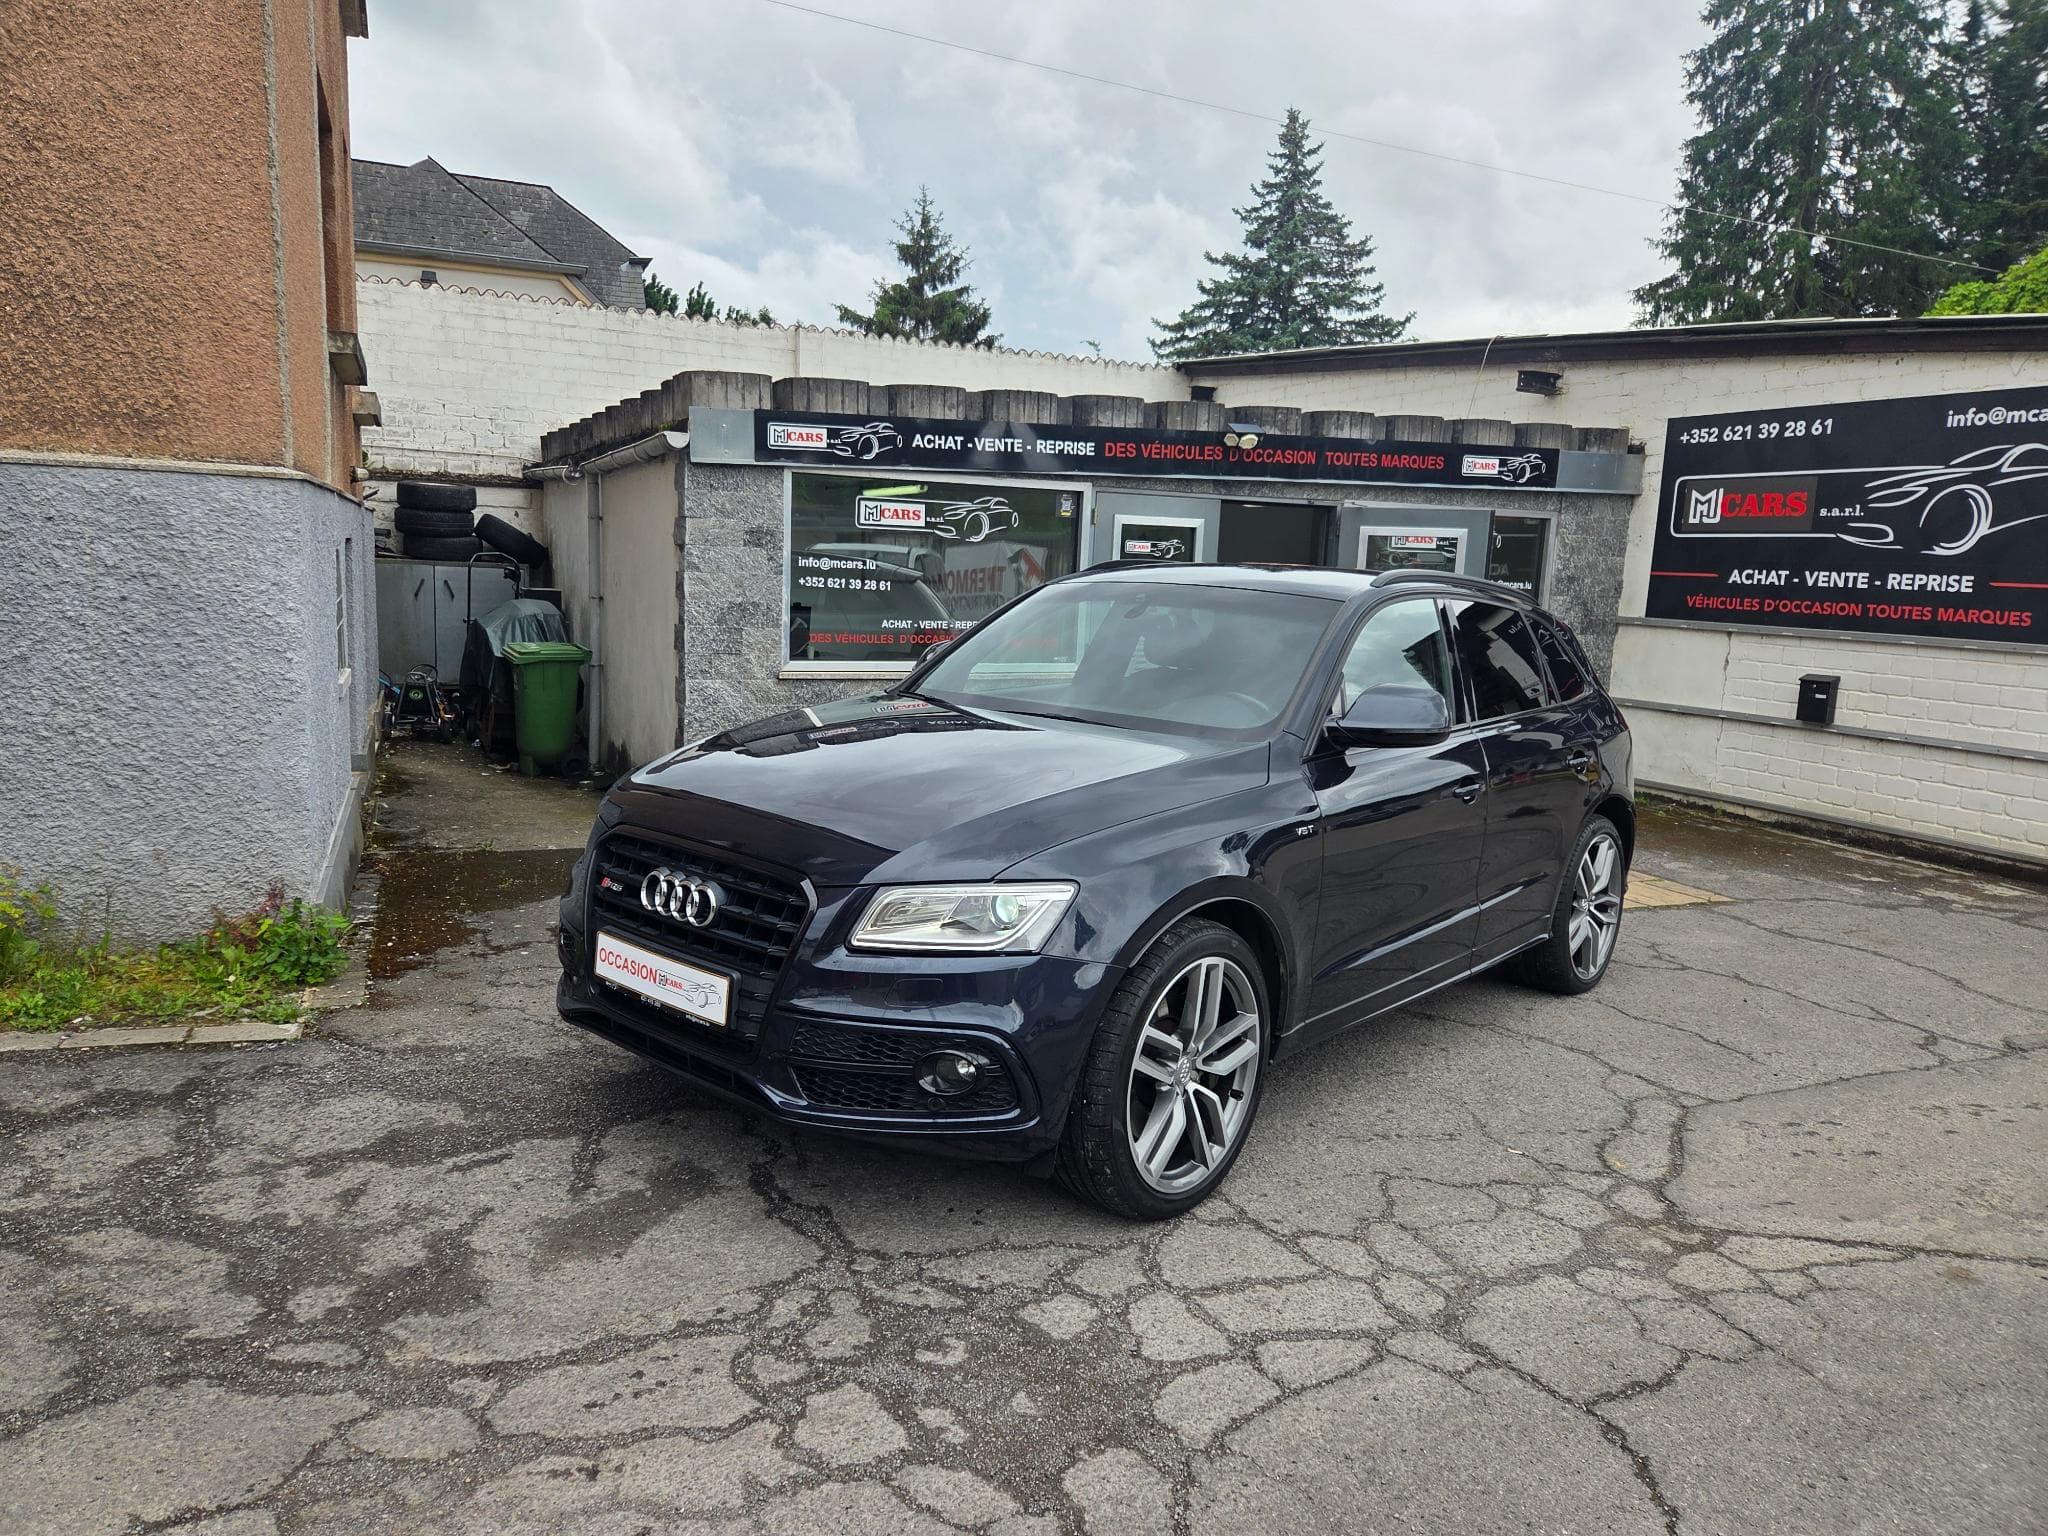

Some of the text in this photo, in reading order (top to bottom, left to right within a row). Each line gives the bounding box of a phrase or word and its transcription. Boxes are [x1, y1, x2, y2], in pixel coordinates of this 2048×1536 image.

[1680, 418, 1833, 444] +352 621 39 28 61
[912, 434, 964, 450] ACHAT
[975, 437, 1023, 452] VENTE
[1036, 439, 1095, 456] REPRISE
[1105, 442, 1136, 457] DES
[1141, 441, 1223, 461] VÉHICULES
[1229, 447, 1316, 465] D'OCCASION
[1326, 452, 1377, 467] TOUTES
[1381, 454, 1445, 470] MARQUES
[1819, 505, 1865, 517] s.a.r.l.
[798, 556, 876, 570] info@mcars.lu
[799, 577, 891, 591] +352 621 39 28 61
[1728, 569, 1790, 586] ACHAT
[1805, 570, 1870, 589] VENTE
[1887, 573, 1975, 593] REPRISE
[1687, 593, 2033, 627] VÉHICULES D'OCCASION TOUTES MARQUES
[881, 620, 912, 629] ACHAT
[919, 620, 949, 629] VENTE
[810, 633, 832, 643] DES
[835, 631, 894, 644] VÉHICULES
[599, 947, 657, 985] OCCASION
